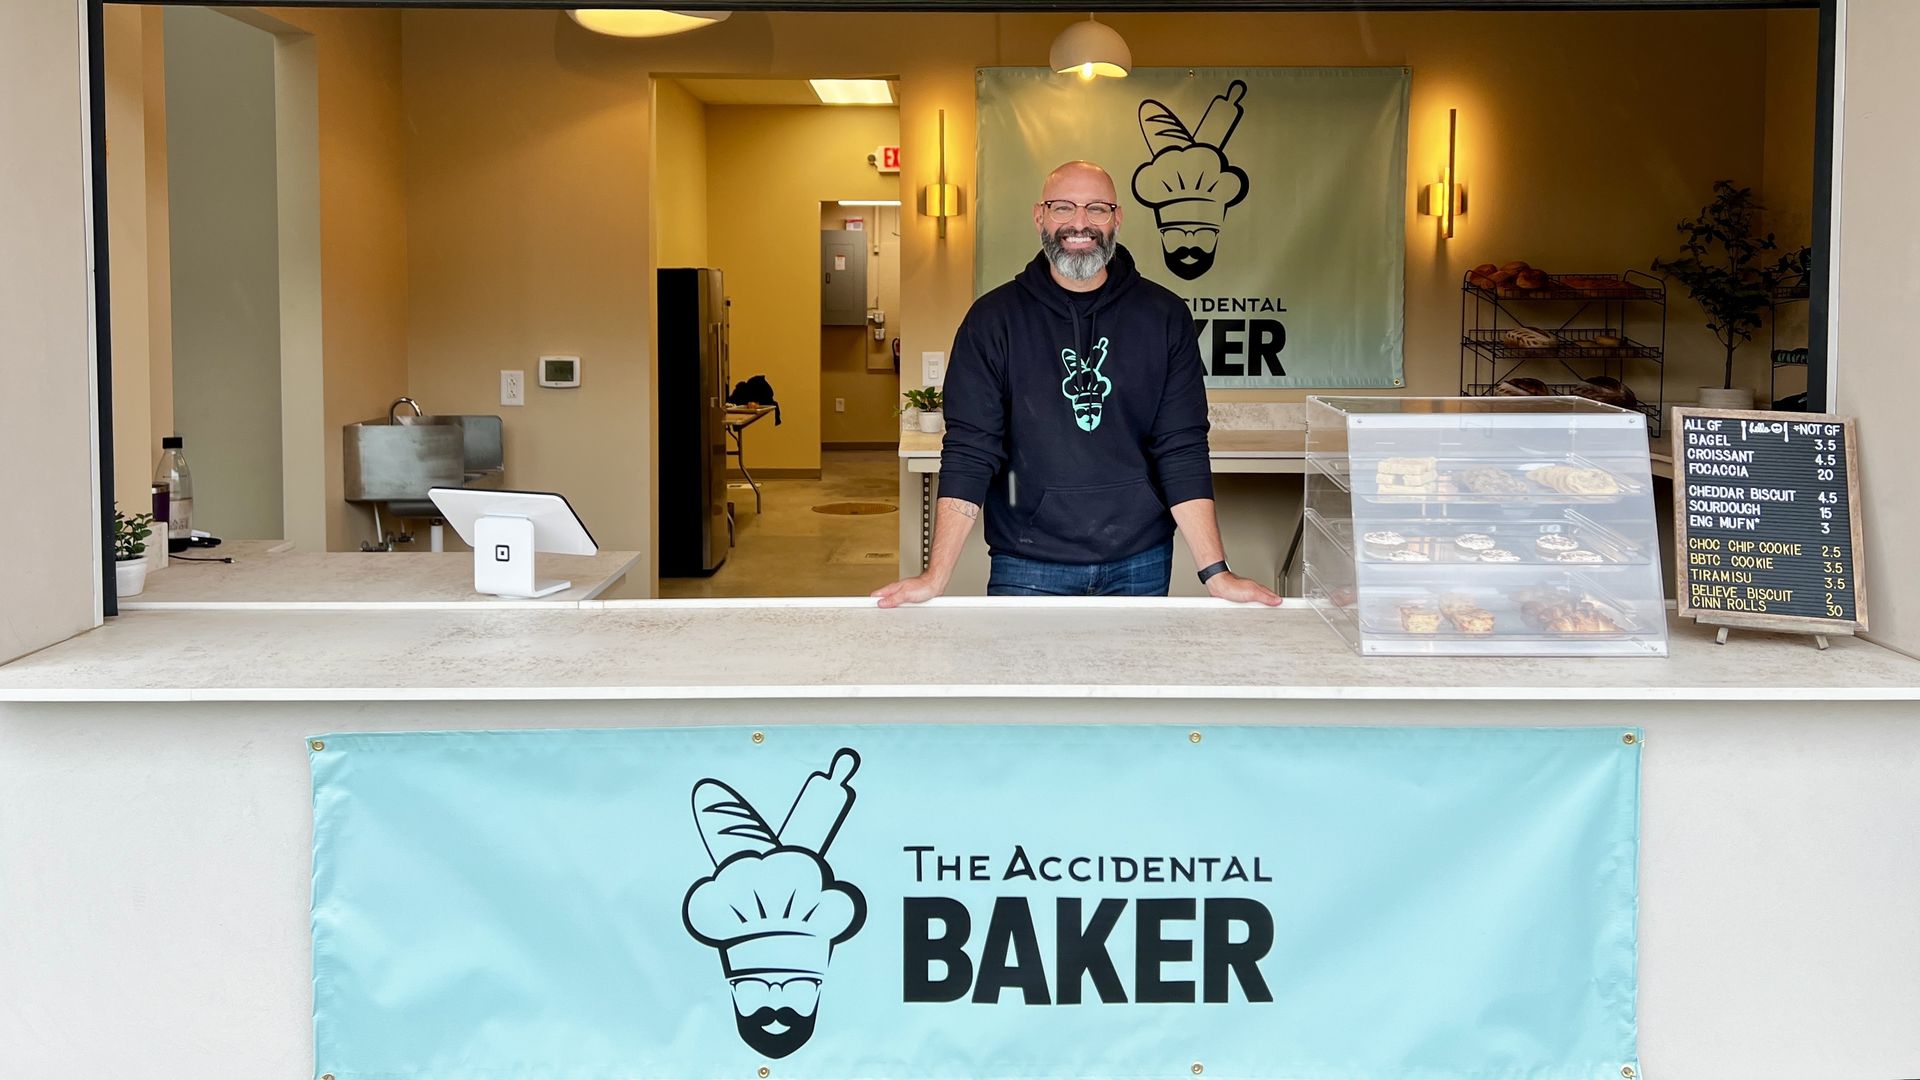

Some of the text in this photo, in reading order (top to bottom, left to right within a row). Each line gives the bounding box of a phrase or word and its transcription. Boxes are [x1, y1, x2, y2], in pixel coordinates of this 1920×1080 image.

[1684, 419, 1723, 432] ALL GF
[1824, 424, 1840, 436] GF
[1689, 434, 1731, 446] BAGEL
[1814, 439, 1836, 451] 3.5
[1687, 448, 1755, 463] CROISSANT
[1814, 454, 1836, 466] 4.5
[1689, 463, 1749, 477] FOCACCIA
[1817, 469, 1833, 480] 20
[1689, 485, 1796, 502] CHEDDAR BISCUIT
[1817, 492, 1838, 504] 4.5
[1689, 500, 1761, 515] SOURDOUGH
[1819, 507, 1832, 519] 15
[1690, 514, 1713, 527] ENG
[1820, 522, 1831, 534] 3
[1689, 538, 1802, 556] CHOC CHIP COOKIE
[1822, 545, 1841, 558] 2.5
[1690, 553, 1774, 569] BBTC COOKIE
[1823, 562, 1843, 574] 3.5
[1690, 569, 1752, 583] TIRAMISU
[1824, 578, 1846, 590] 3.5
[1691, 584, 1793, 602] BELIEVE BISCUIT
[1825, 593, 1834, 604] 2
[1692, 596, 1767, 612] CINN ROLLS
[1826, 606, 1843, 617] 30
[903, 896, 1274, 1005] BAKER
